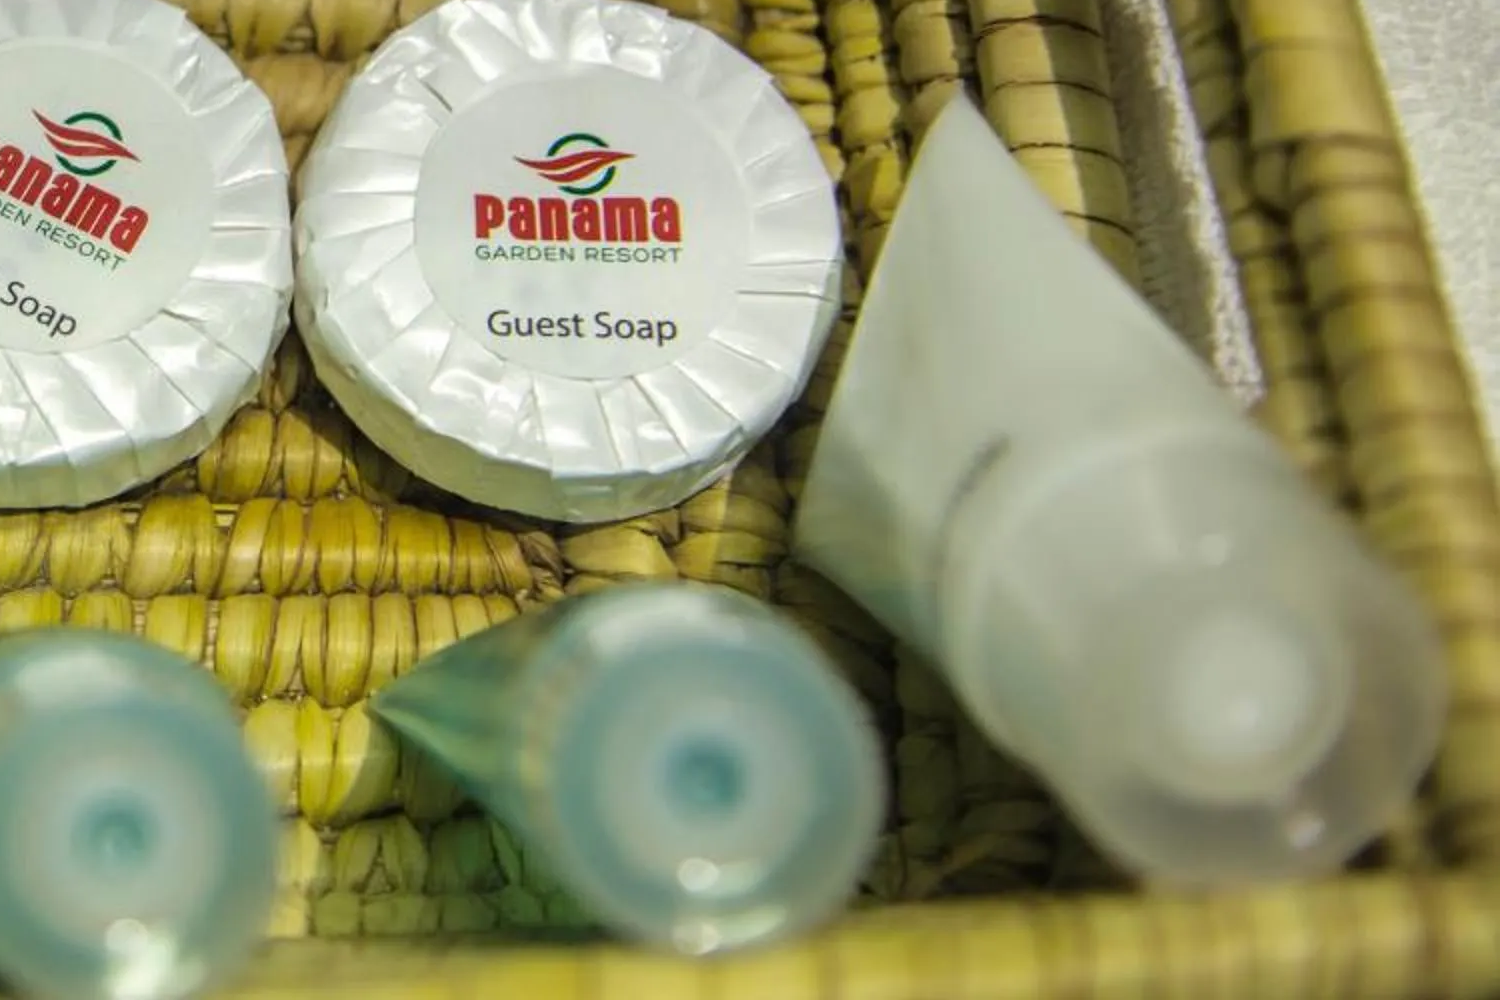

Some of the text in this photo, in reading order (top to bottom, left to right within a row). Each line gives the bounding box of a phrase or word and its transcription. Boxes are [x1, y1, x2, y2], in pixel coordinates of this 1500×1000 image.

[35, 218, 126, 272] RESORT
[475, 245, 683, 263] GARDEN RESORT
[0, 280, 77, 338] Soap
[487, 310, 678, 347] Guest Soap
